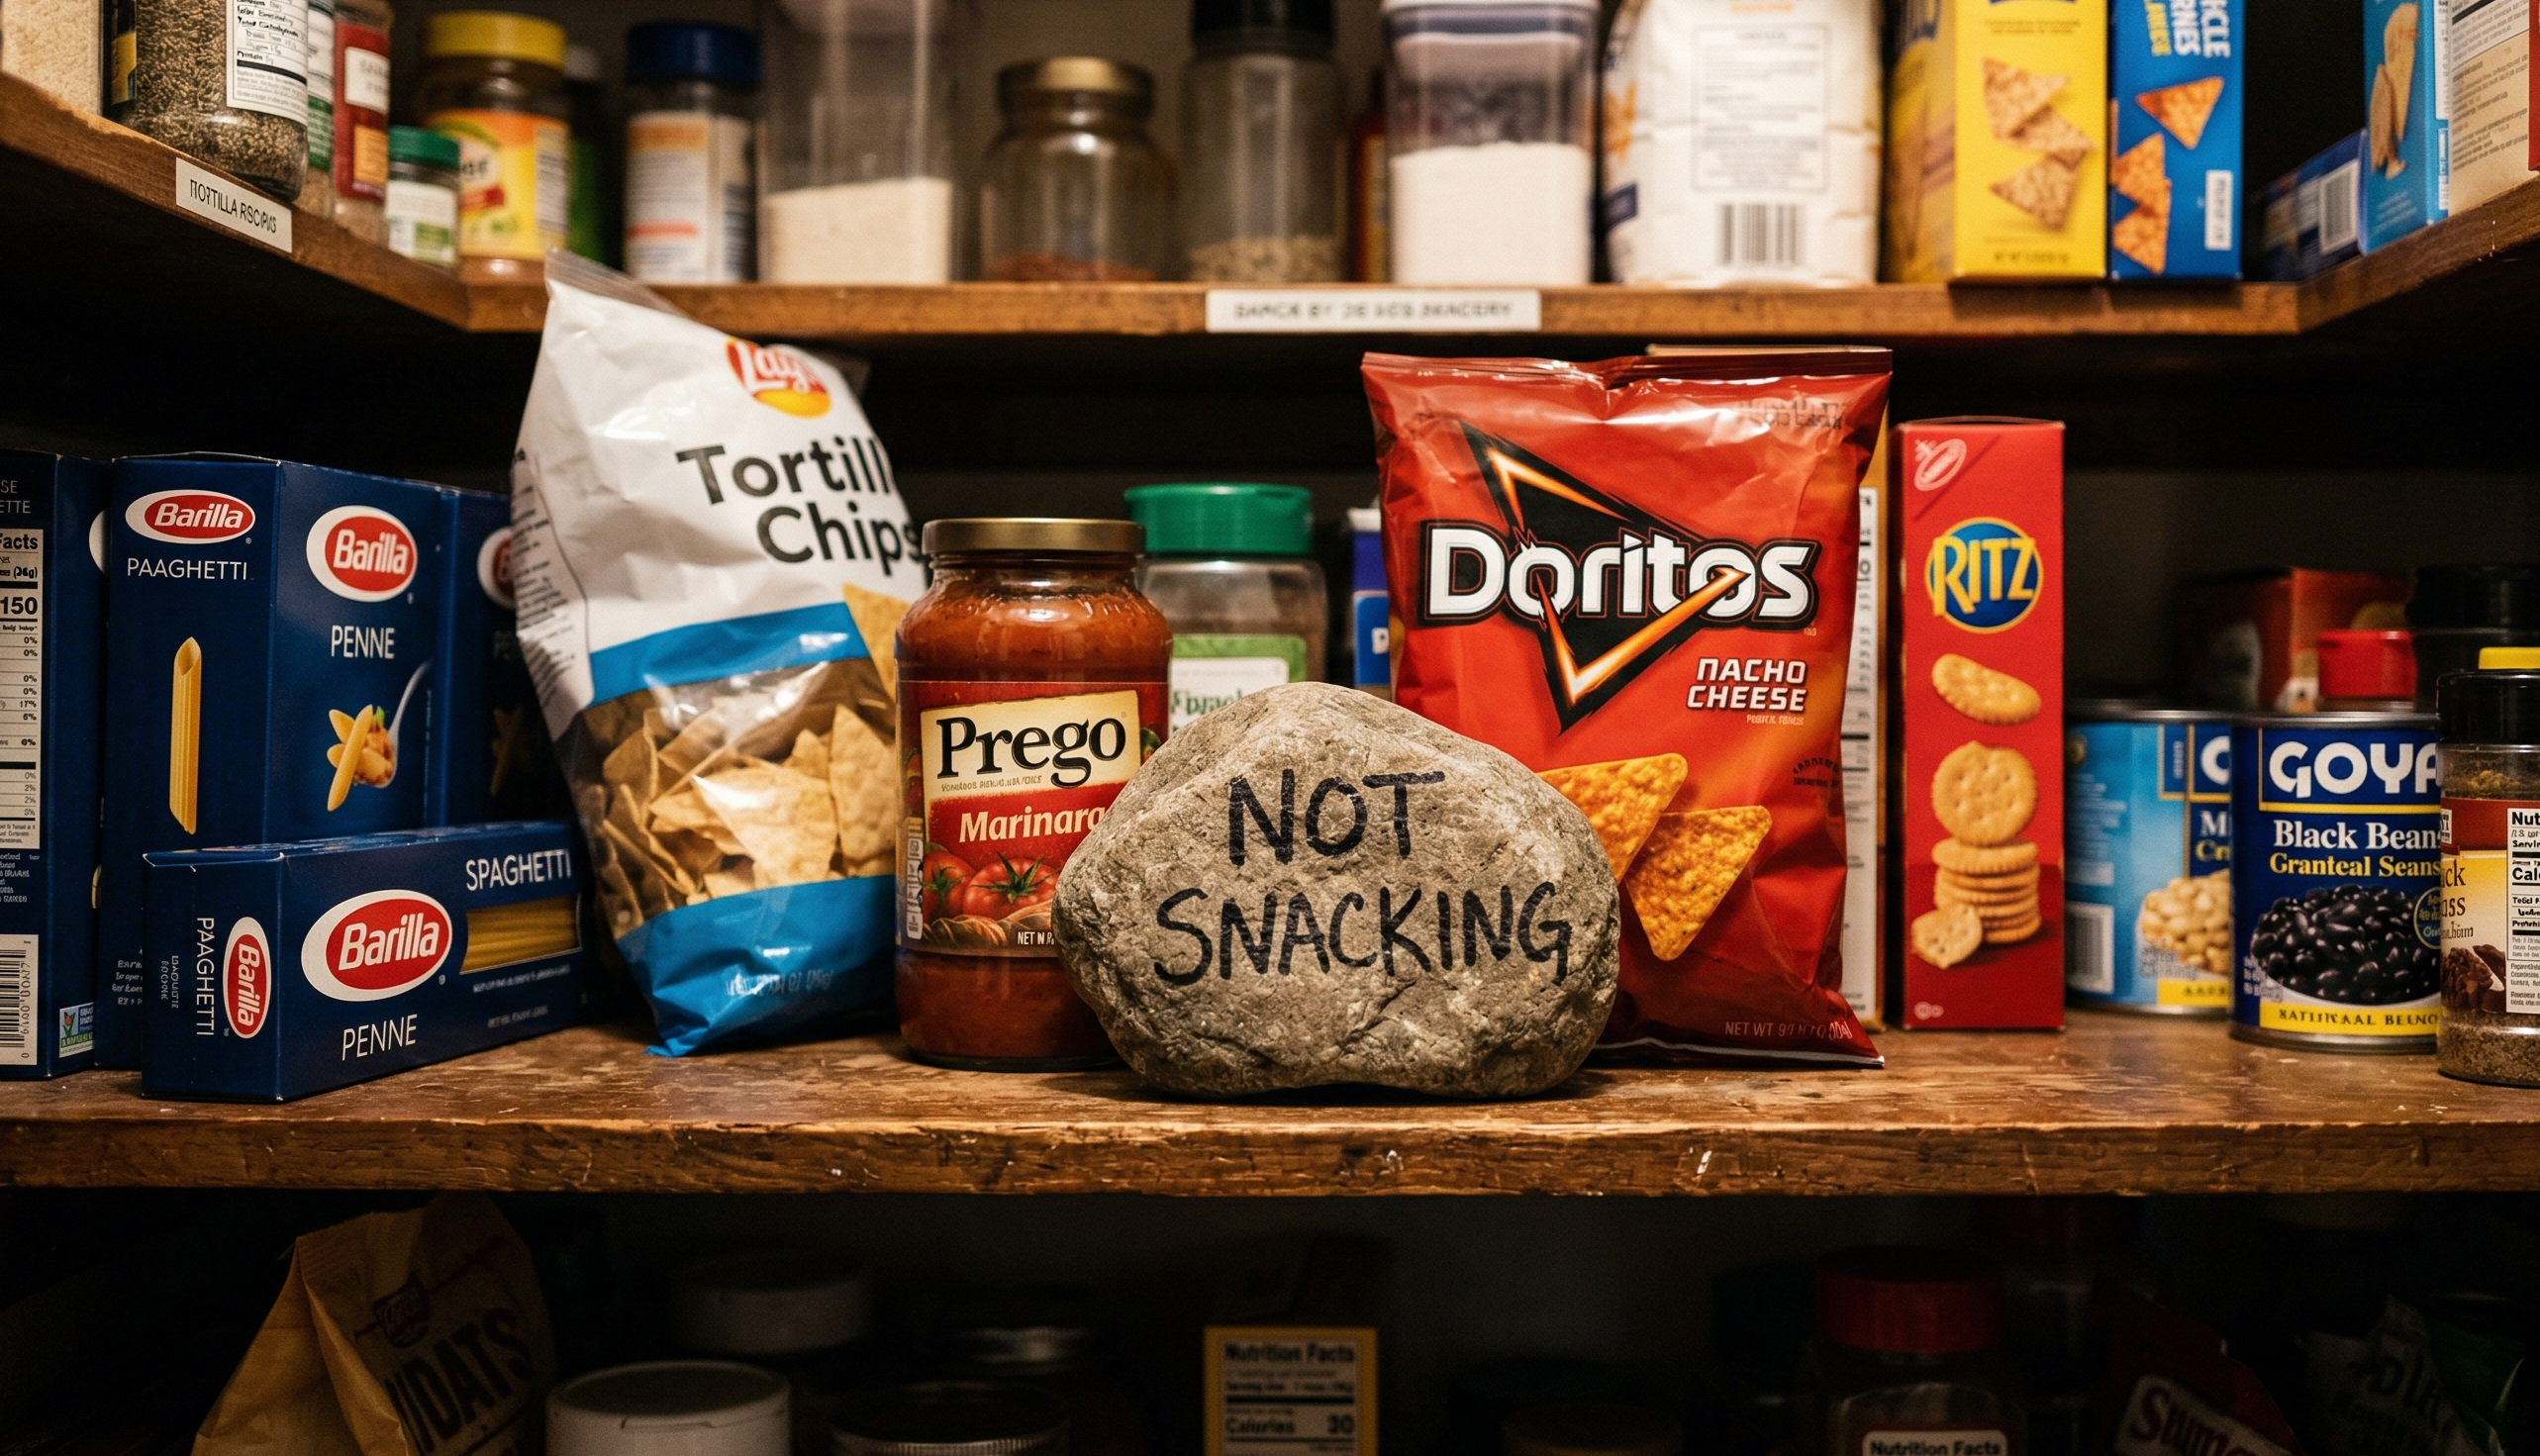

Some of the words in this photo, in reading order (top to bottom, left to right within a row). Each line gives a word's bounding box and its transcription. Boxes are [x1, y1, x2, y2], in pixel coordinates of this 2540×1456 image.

[153, 502, 244, 531] Barilla
[0, 534, 39, 549] acts
[333, 528, 410, 576] Barilla
[127, 557, 247, 581] PAAGHETTI
[1429, 529, 1810, 618] Doritos
[1932, 535, 2036, 618] RITZ
[331, 625, 396, 660] PENNE
[1697, 657, 1807, 685] NACHO
[1687, 684, 1807, 713] CHEESE
[935, 716, 1126, 789] Prego
[1227, 768, 1445, 867] NOT
[2273, 819, 2359, 850] Black
[2365, 822, 2441, 851] Bean
[465, 848, 573, 893] SPAGHETTI
[2268, 851, 2372, 877] Granteal
[338, 911, 440, 972] Barilla
[1018, 931, 1035, 945] NET
[1154, 881, 1573, 987] SNACKING
[237, 942, 261, 1028] Barilla
[342, 1014, 419, 1062] PENNE
[1724, 1021, 1750, 1036] NET
[1753, 1021, 1775, 1037] WT
